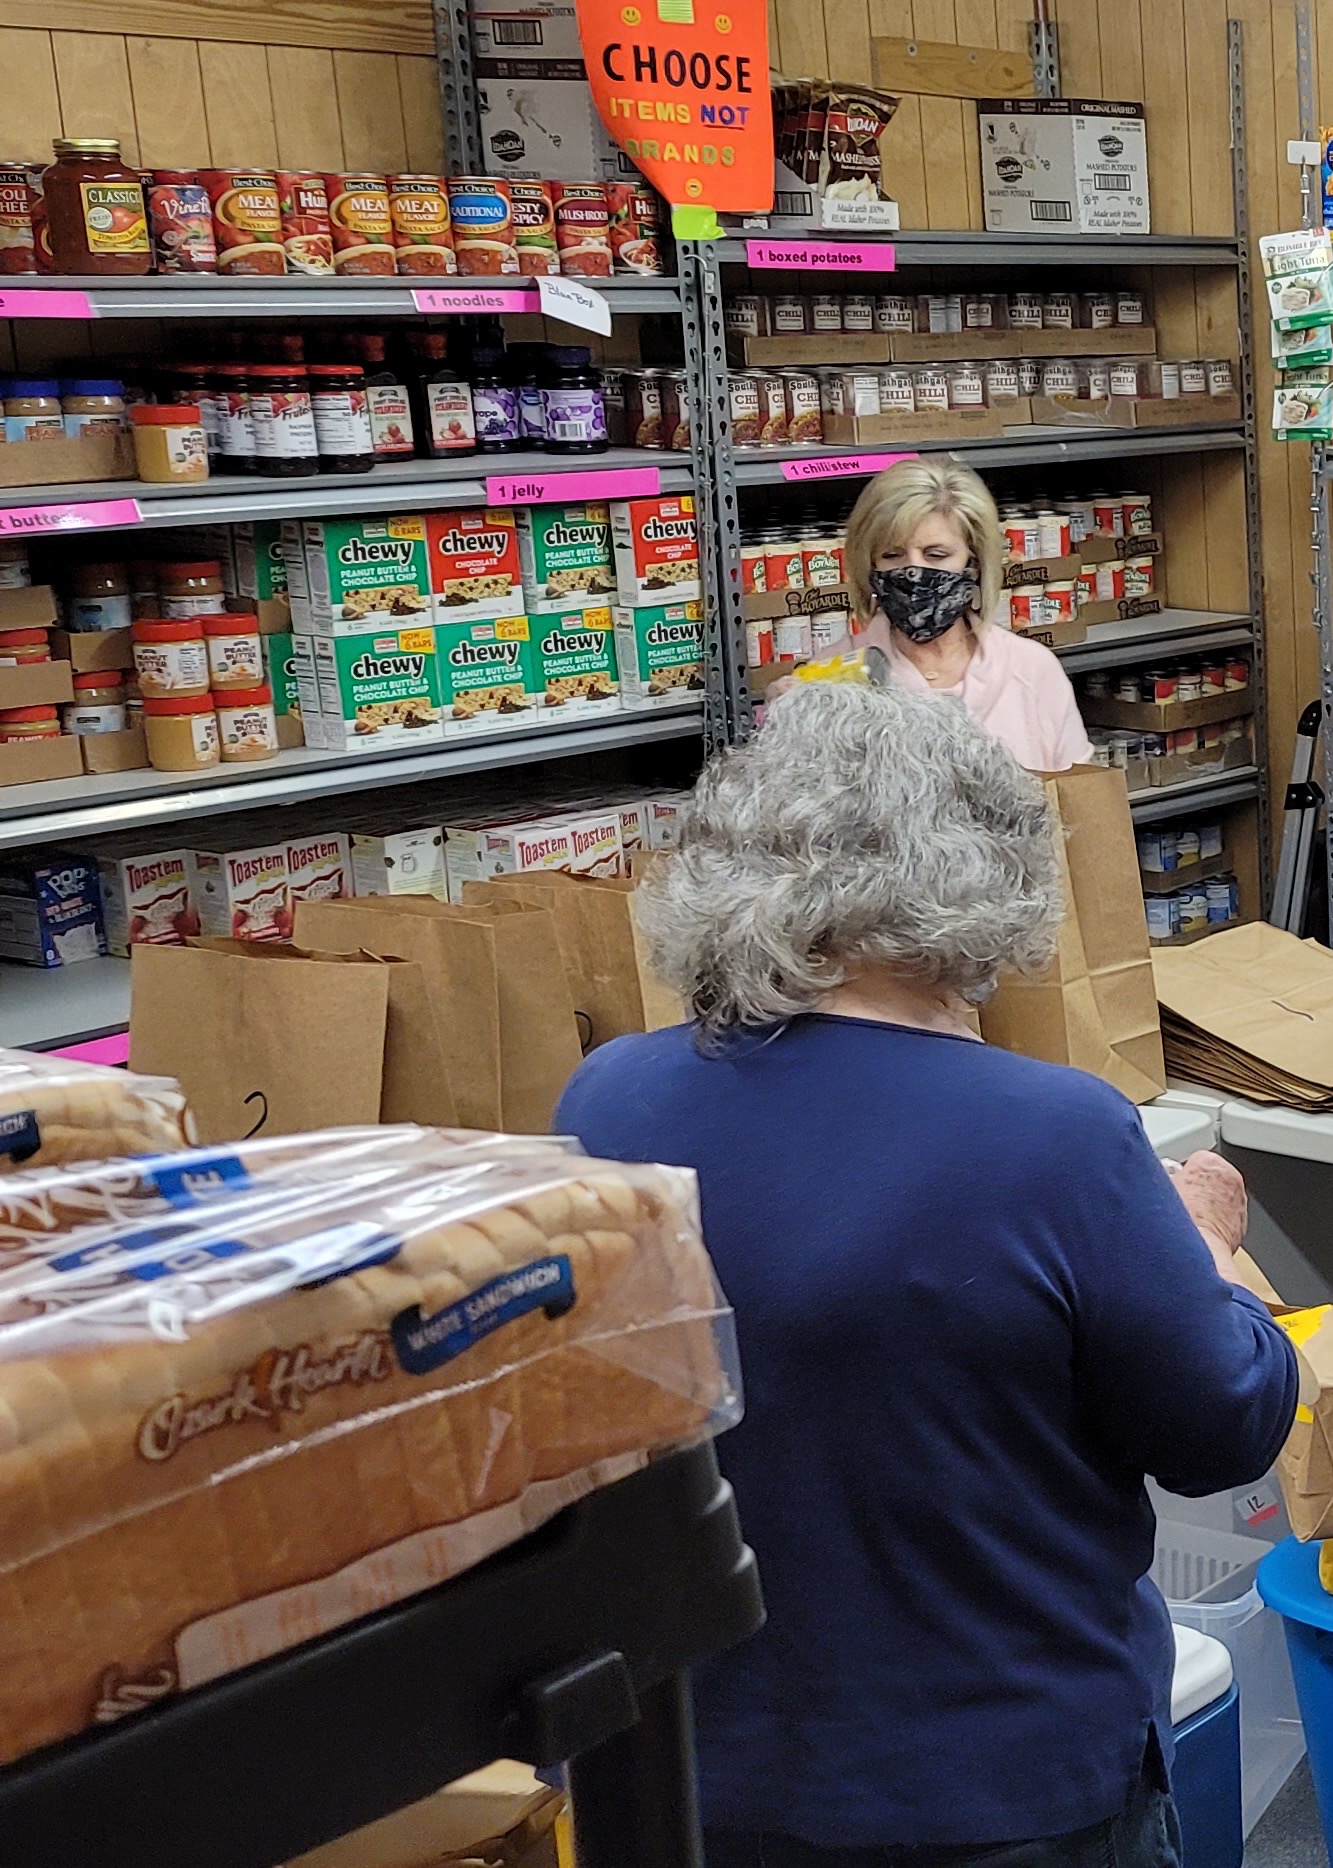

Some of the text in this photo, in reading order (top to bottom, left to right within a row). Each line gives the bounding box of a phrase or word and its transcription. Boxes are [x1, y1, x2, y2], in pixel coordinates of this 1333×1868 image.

[602, 43, 752, 93] CHOOSE
[610, 97, 750, 125] ITEMS NOT
[624, 139, 735, 166] BRANDS
[397, 200, 440, 213] MEAT
[757, 250, 863, 265] 1 boxed potatoes
[1300, 256, 1325, 267] Tuna
[427, 294, 504, 307] 1 noodles
[791, 465, 799, 475] 1
[499, 482, 545, 499] 1 jelly
[440, 531, 507, 555] chewy
[544, 522, 607, 547] chewy
[340, 538, 413, 565] chewy
[451, 639, 520, 665] chewy
[542, 631, 605, 655] chewy
[352, 653, 424, 679] chewy
[137, 1332, 391, 1460] Ozark Hearth
